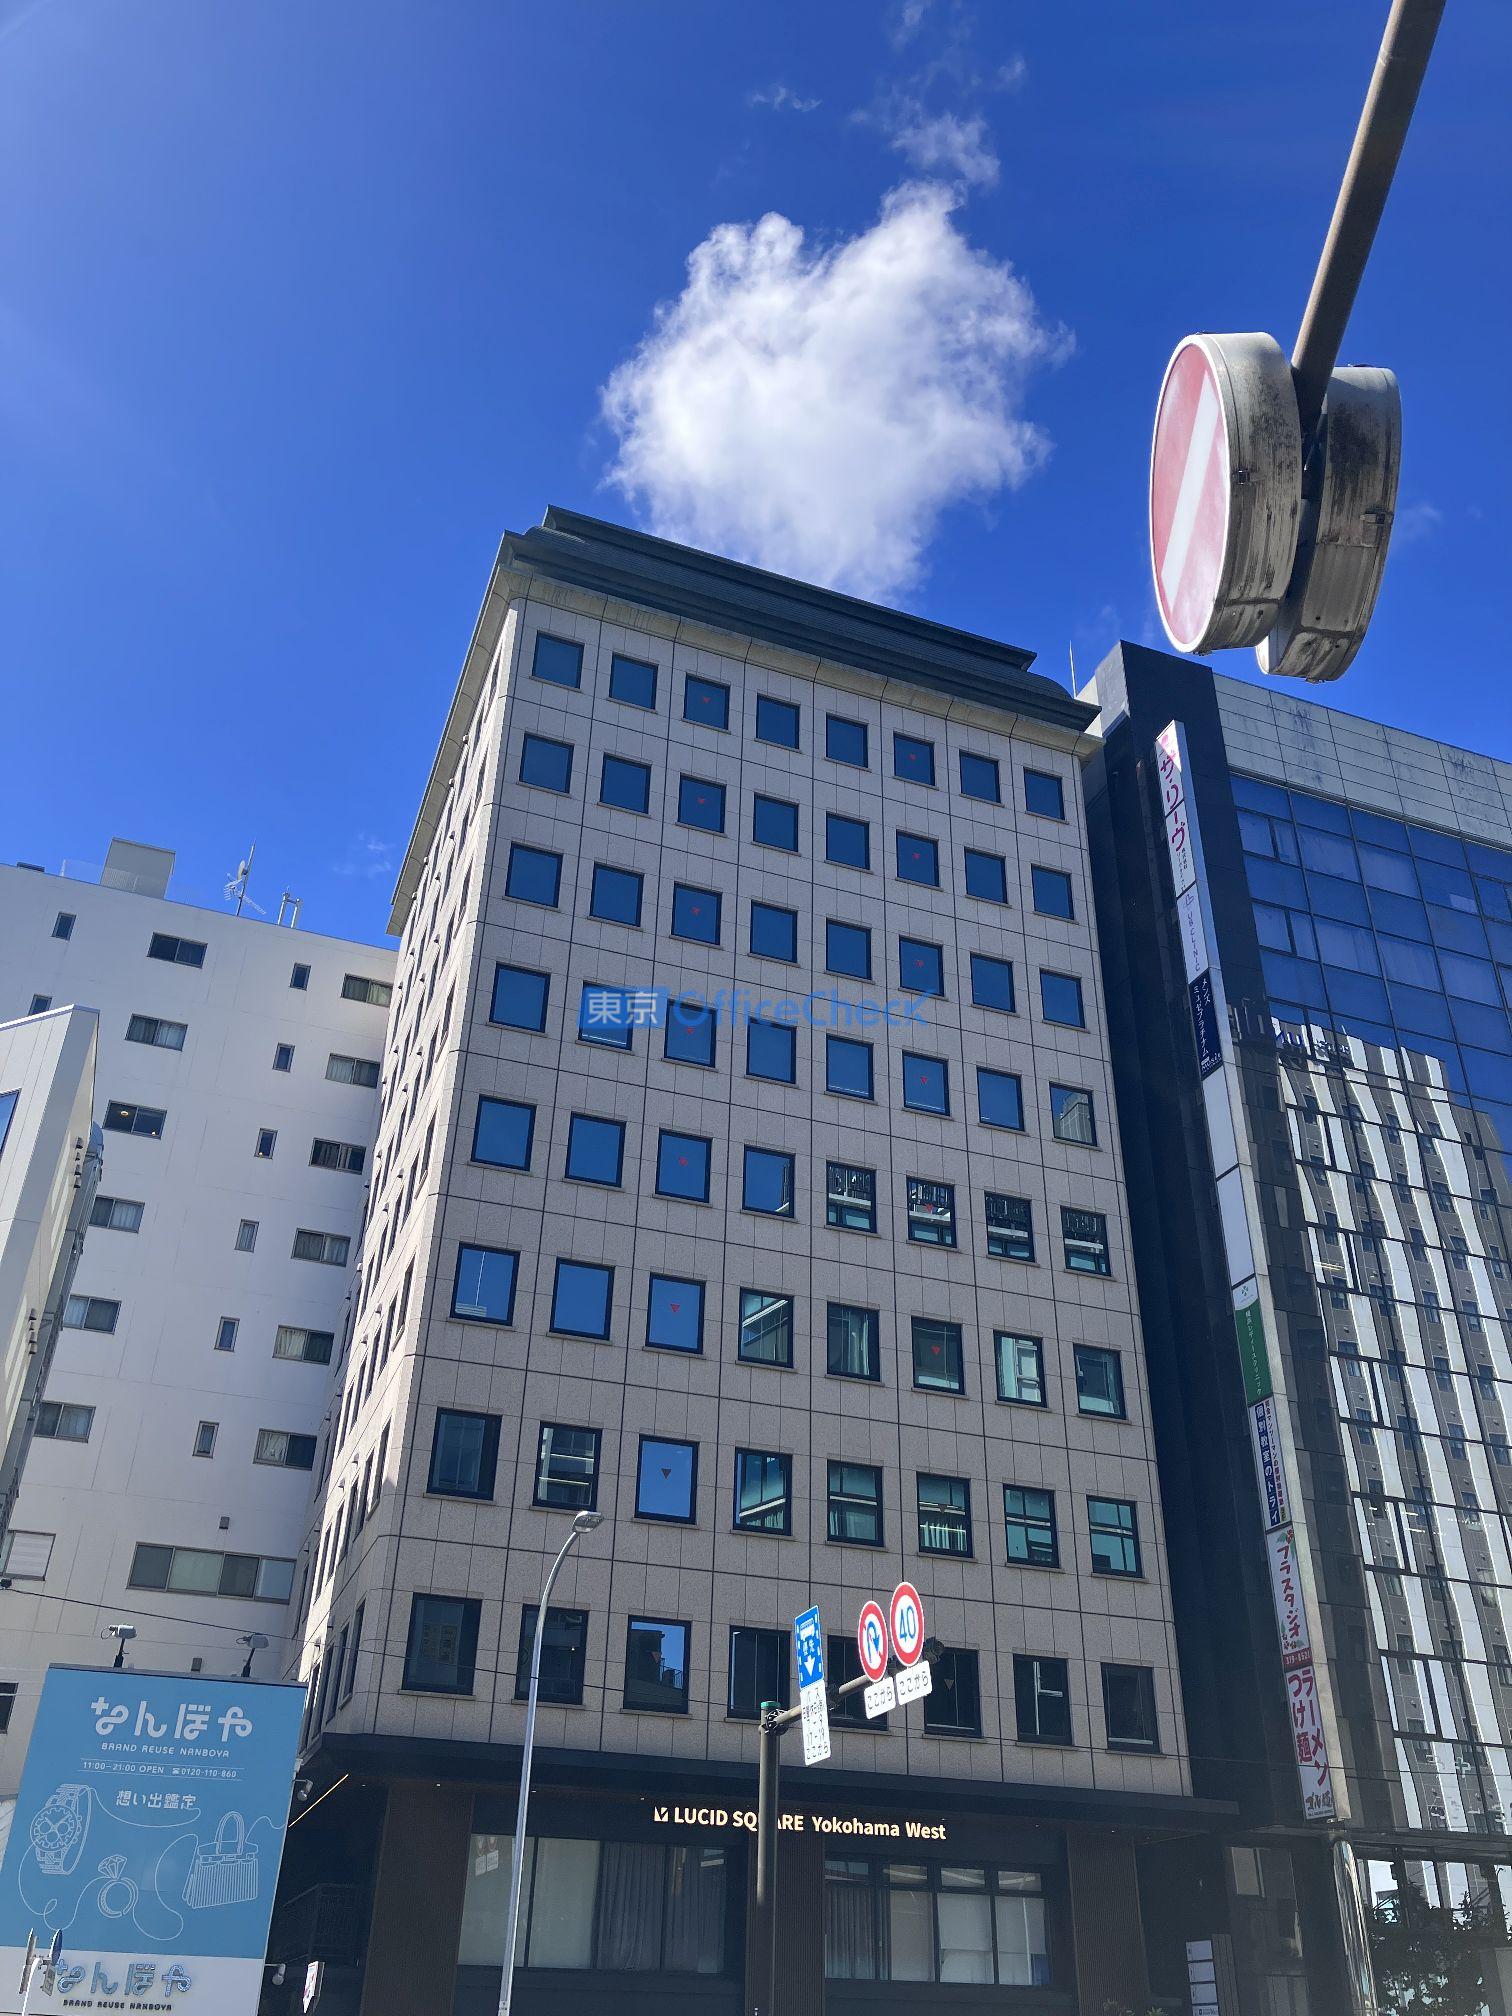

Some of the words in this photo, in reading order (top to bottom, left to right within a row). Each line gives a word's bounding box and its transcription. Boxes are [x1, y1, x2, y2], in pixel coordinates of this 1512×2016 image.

[1277, 1546, 1301, 1638] フラスタジオ
[900, 1605, 917, 1642] 40
[867, 1686, 893, 1710] ここから
[899, 1670, 929, 1696] ここから
[91, 1696, 253, 1742] なんぼや
[1287, 1674, 1314, 1765] つけ麺
[1302, 1668, 1329, 1787] ラーメン
[101, 1742, 137, 1752] BRAND
[141, 1745, 175, 1755] REUSE
[179, 1748, 230, 1758] NANBOYA
[138, 1765, 165, 1774] OPEN
[115, 1790, 197, 1810] 想い出鑑定
[673, 1807, 728, 1827] LUCID
[811, 1816, 900, 1837] Yokohama
[905, 1822, 947, 1840] West
[55, 1958, 192, 1998] なんぼや
